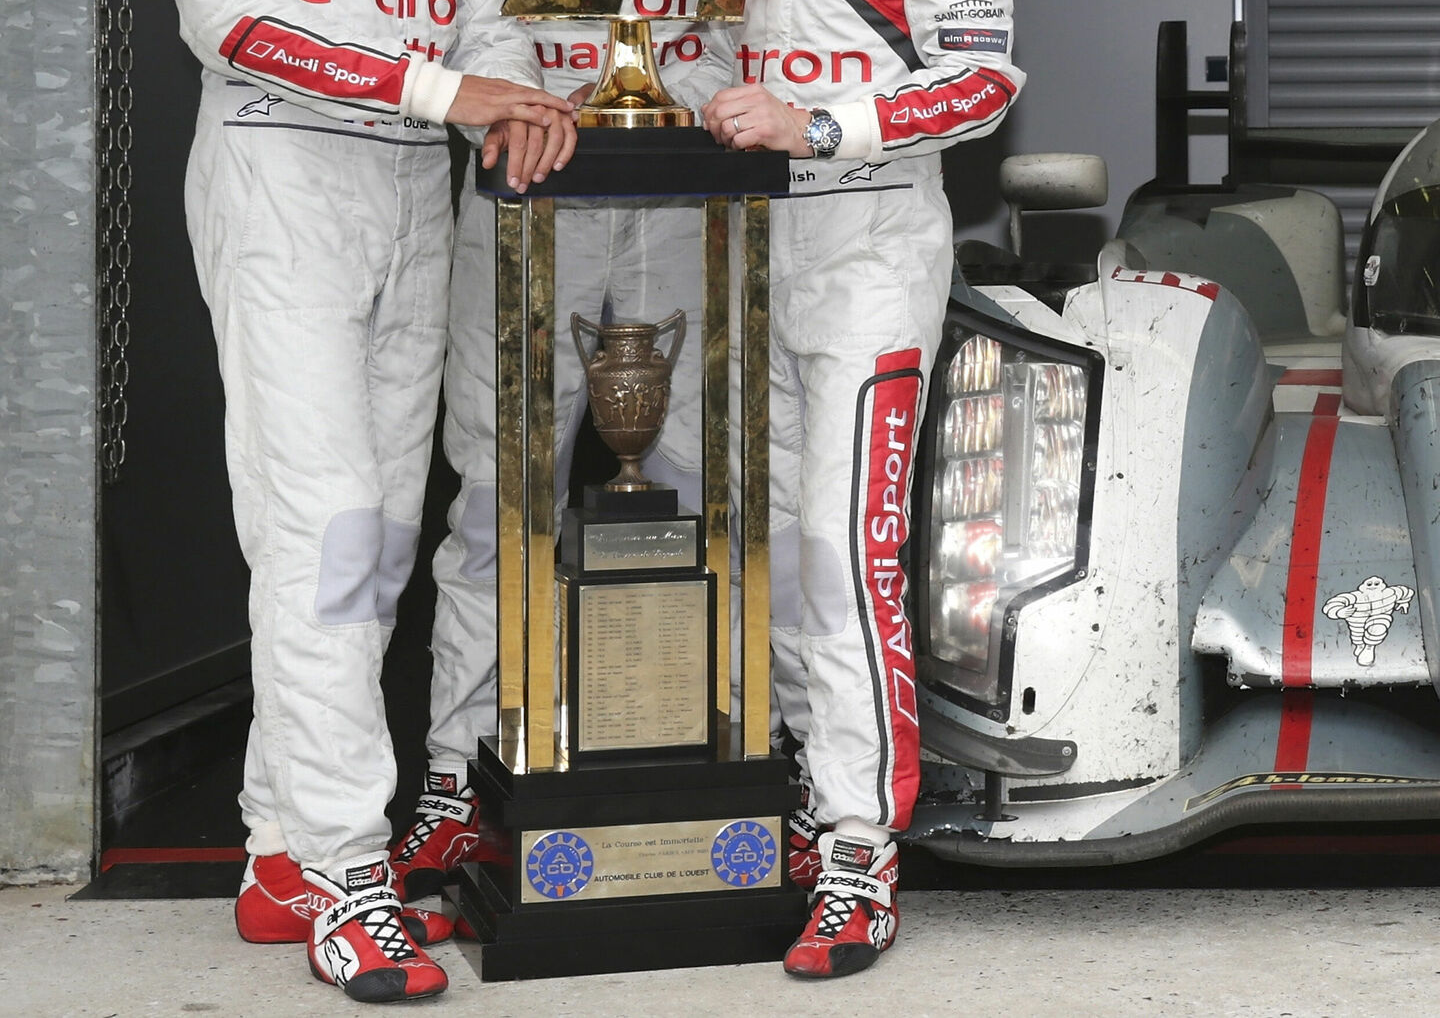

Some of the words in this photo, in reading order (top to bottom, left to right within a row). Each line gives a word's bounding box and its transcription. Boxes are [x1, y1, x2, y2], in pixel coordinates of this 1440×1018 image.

[934, 8, 1006, 23] SAINT-GOBAIN
[272, 48, 319, 72] Audi
[323, 62, 378, 86] Sport
[736, 44, 872, 84] tron
[912, 100, 948, 119] Audi
[951, 83, 996, 112] Sport
[871, 407, 907, 543] Sport
[594, 872, 641, 882] AUTOMOBILE
[644, 871, 664, 880] CLUB
[667, 870, 677, 878] DE
[679, 868, 709, 878] L'OUEST
[326, 890, 398, 926] alpinestar
